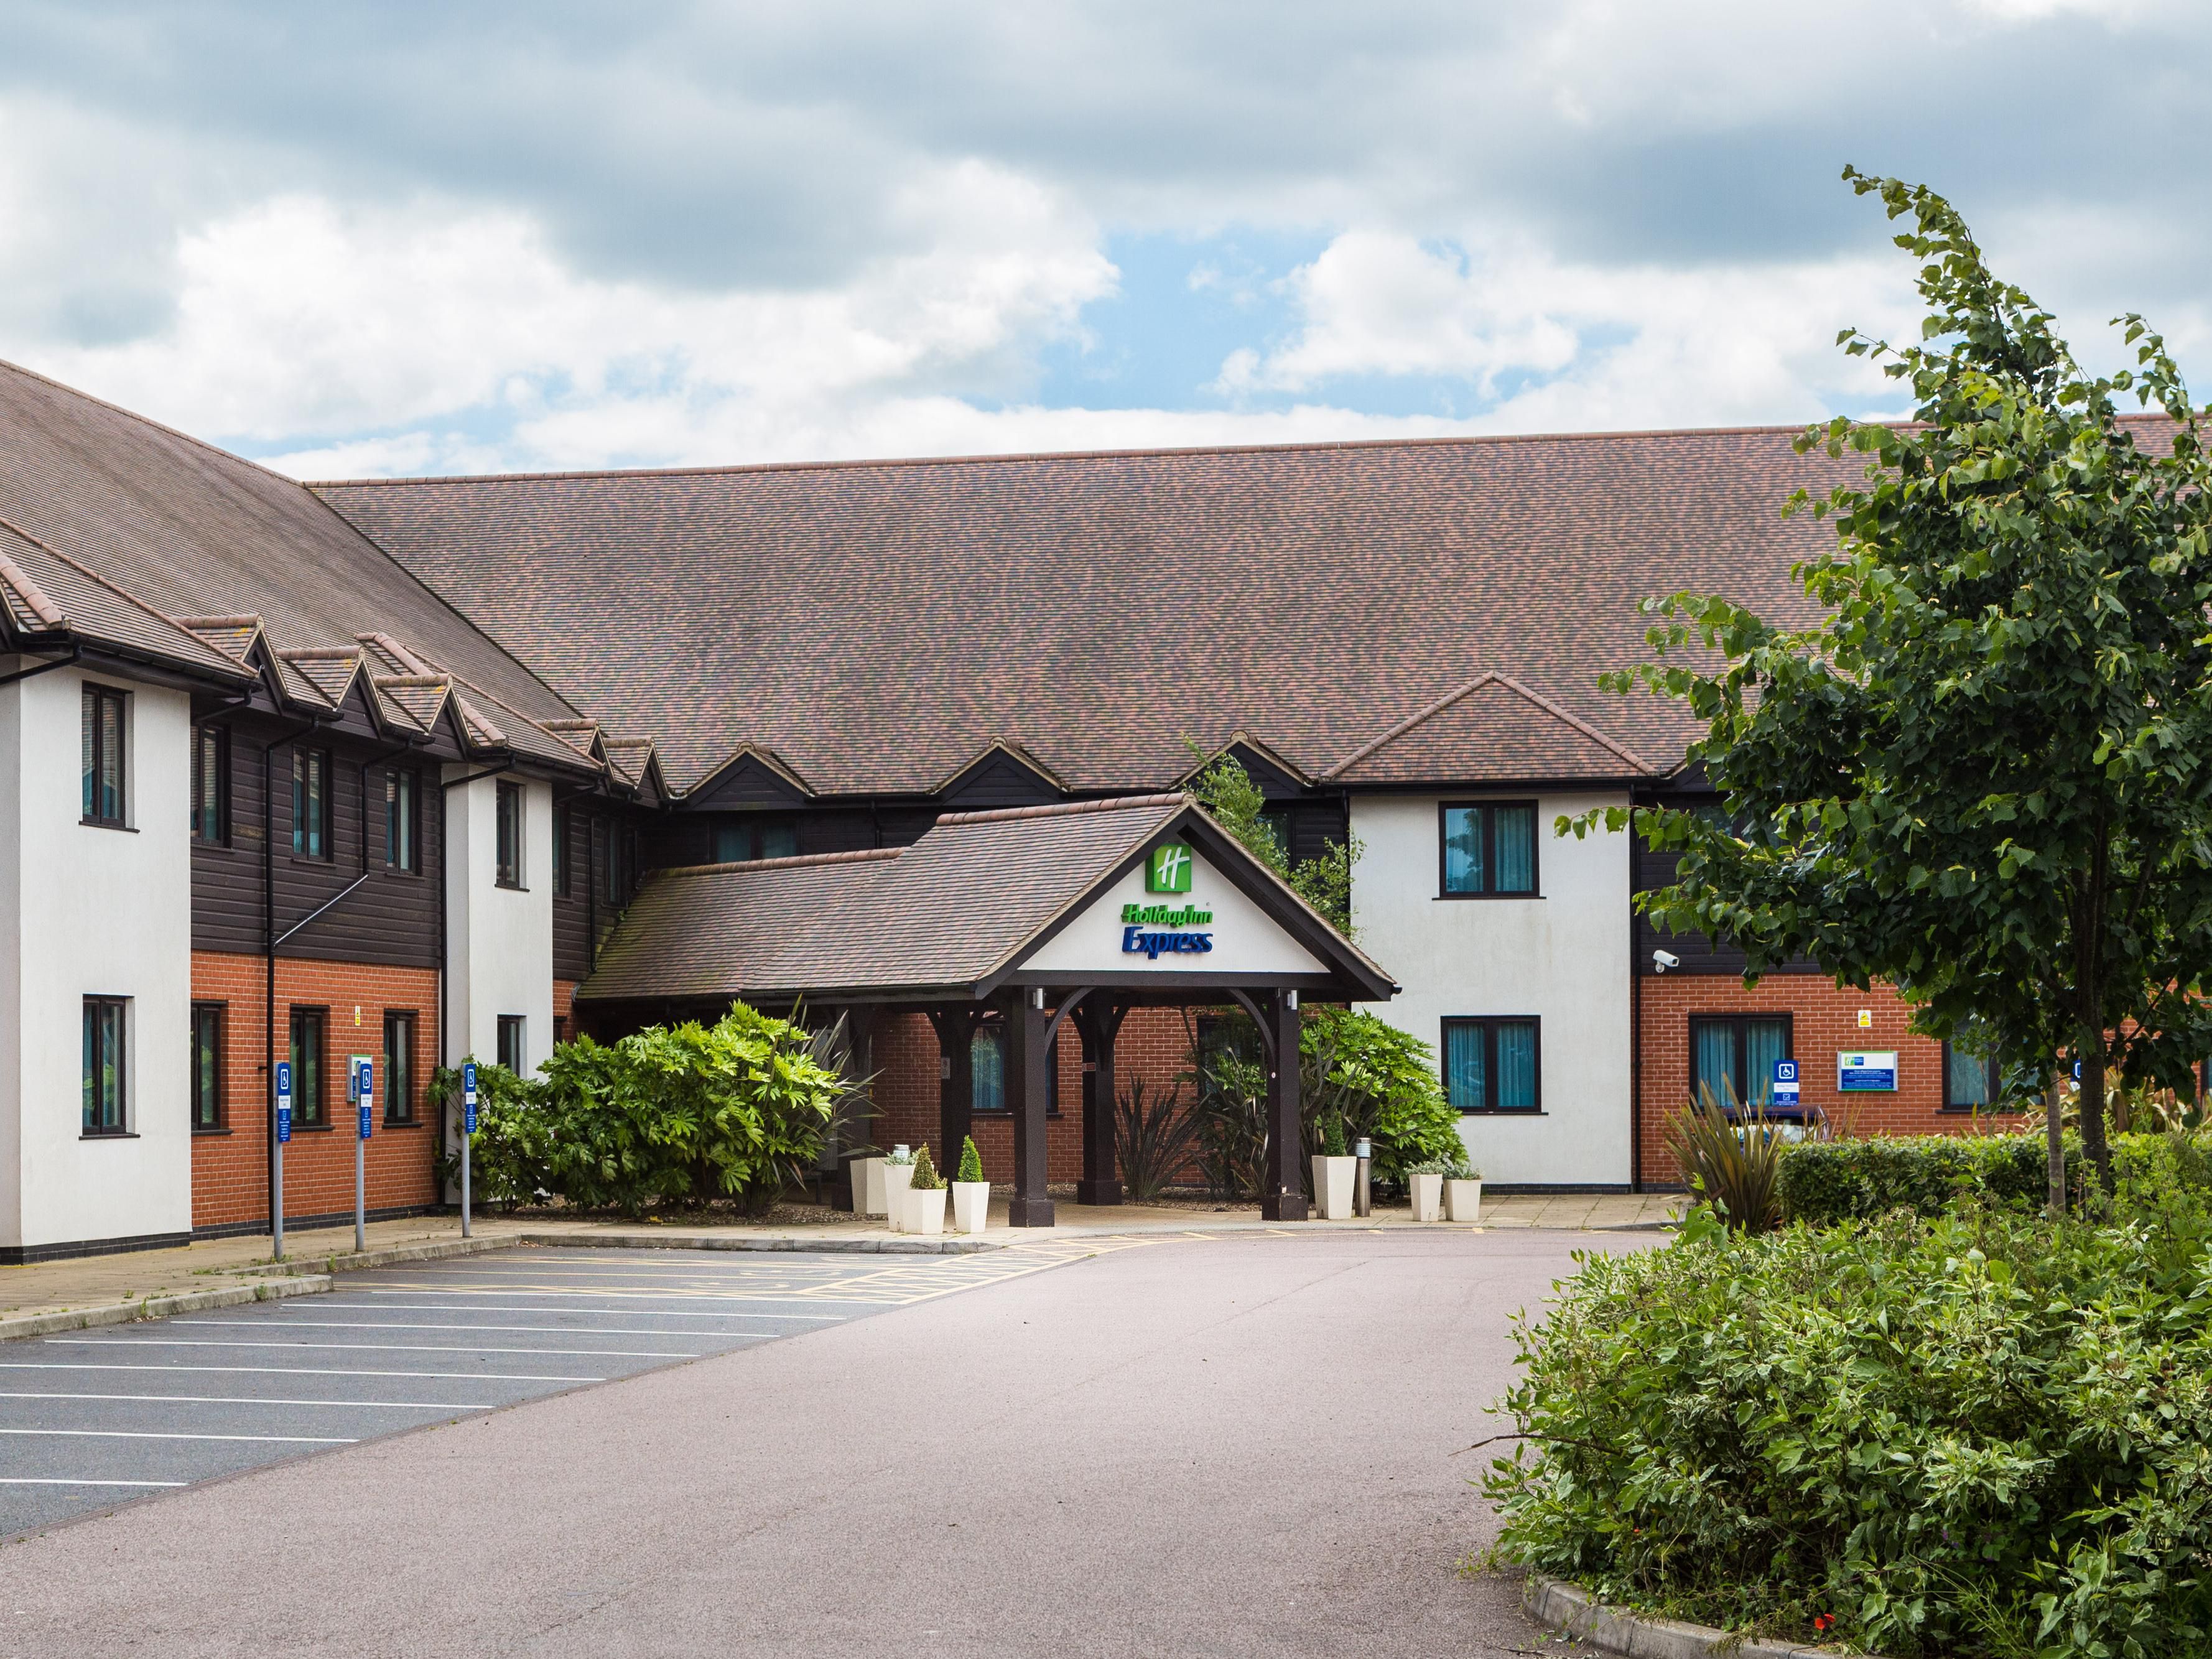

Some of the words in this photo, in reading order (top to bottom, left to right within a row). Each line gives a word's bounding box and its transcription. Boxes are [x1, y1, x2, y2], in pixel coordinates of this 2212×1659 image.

[1121, 904, 1187, 927] Holiday
[1186, 904, 1213, 924] Inn
[1122, 926, 1213, 959] Express
